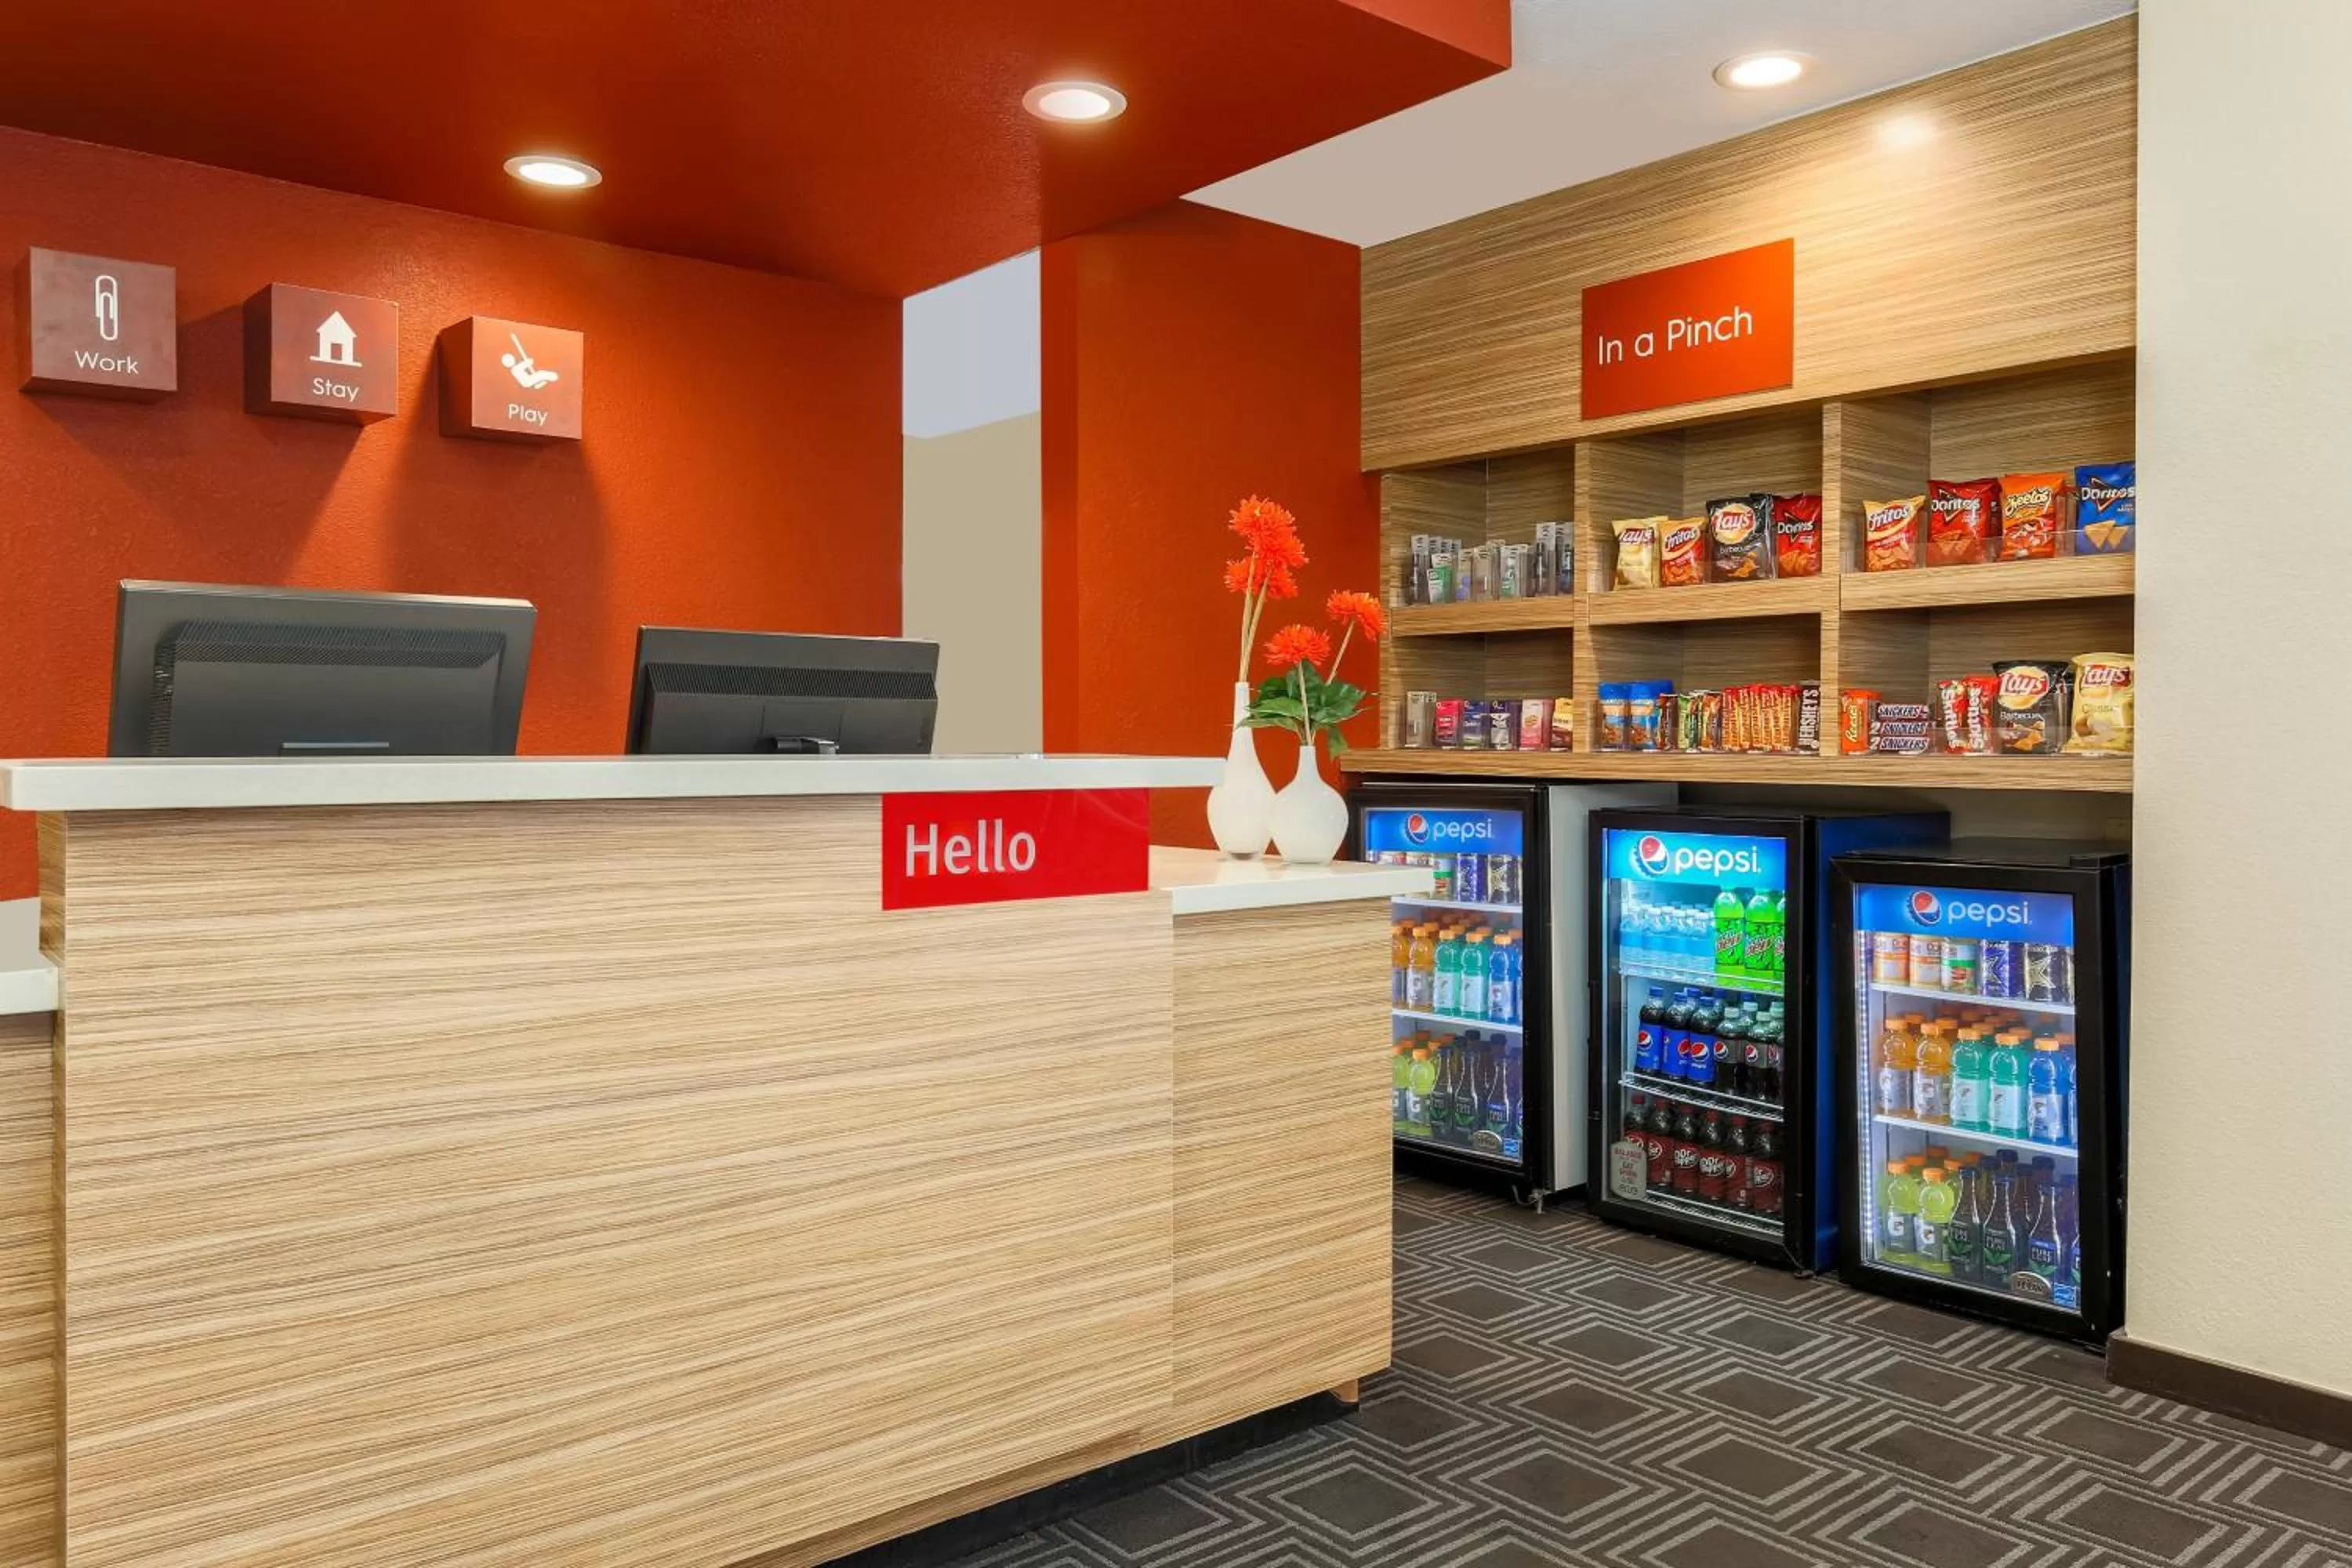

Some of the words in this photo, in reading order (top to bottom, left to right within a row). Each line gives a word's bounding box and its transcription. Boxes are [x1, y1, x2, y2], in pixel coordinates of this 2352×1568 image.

[1598, 336, 1624, 365] In
[1634, 332, 1654, 357] a
[1668, 305, 1753, 351] Pinch
[74, 350, 140, 375] Work
[312, 376, 360, 402] Stay
[507, 403, 548, 426] Play
[2081, 486, 2135, 501] Doritos
[1868, 503, 1911, 531] Fritos
[1433, 818, 1493, 843] pepsi
[905, 818, 1036, 877] Hello
[1674, 846, 1759, 877] pepsi
[1947, 901, 2030, 927] pepsi
